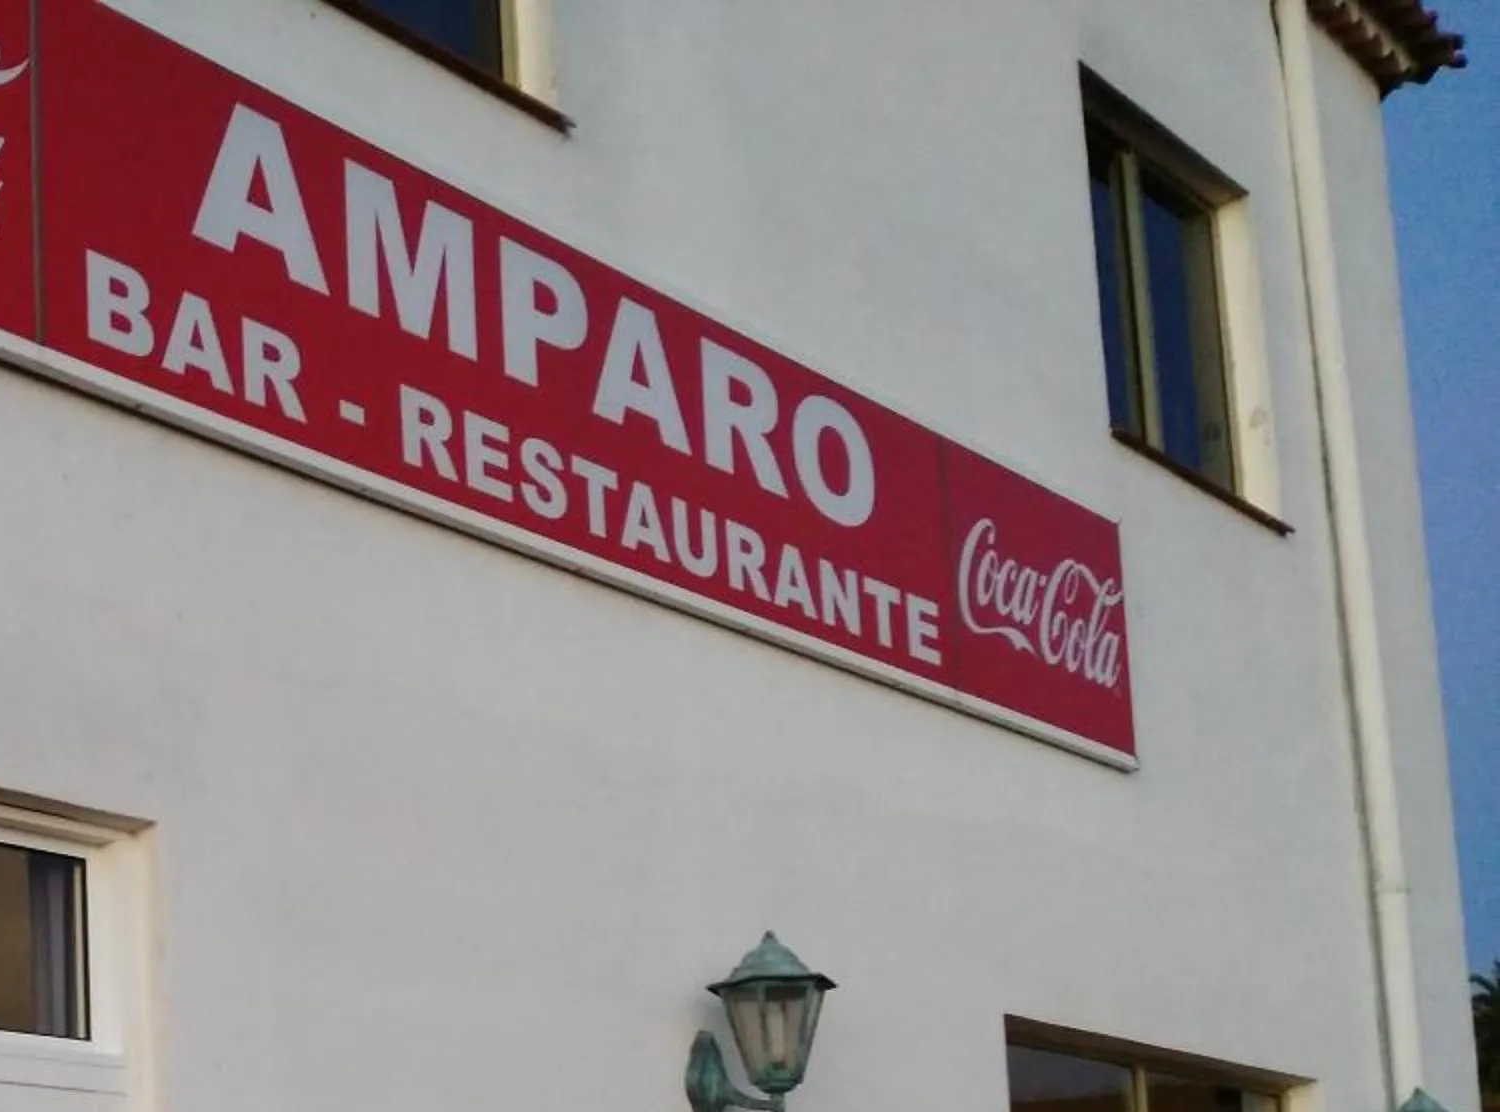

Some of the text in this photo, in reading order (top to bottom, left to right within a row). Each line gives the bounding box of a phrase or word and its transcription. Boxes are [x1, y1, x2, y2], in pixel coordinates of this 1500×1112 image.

[85, 248, 308, 424] BAR
[399, 383, 943, 666] RESTAURANTE
[191, 102, 876, 528] AMPARO
